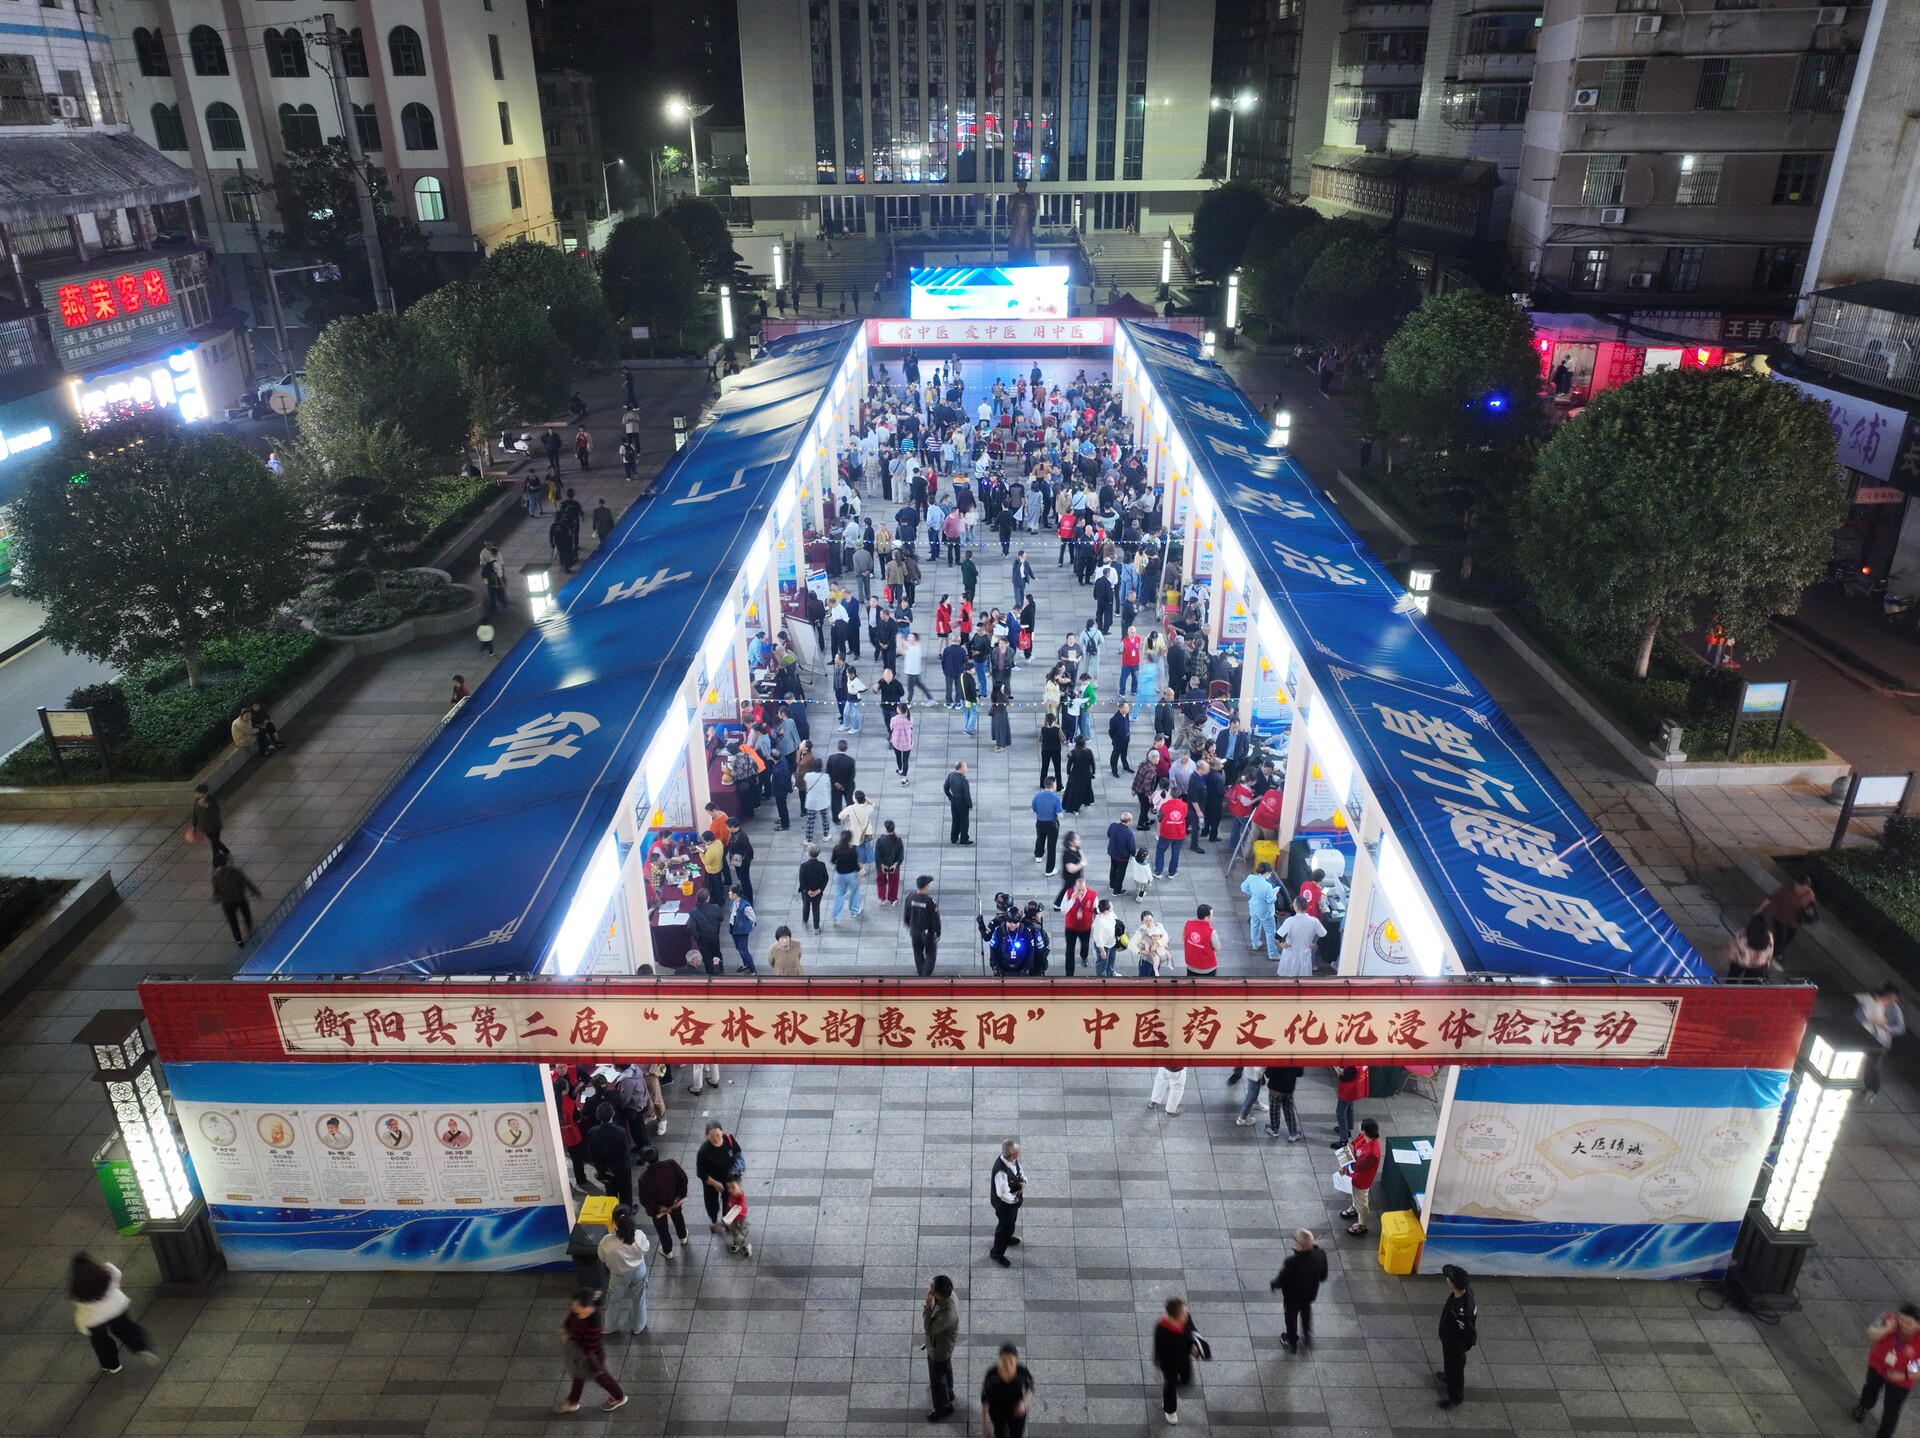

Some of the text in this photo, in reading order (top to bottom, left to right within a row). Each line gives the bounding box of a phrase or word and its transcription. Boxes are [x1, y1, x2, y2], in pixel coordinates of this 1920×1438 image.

[58, 267, 169, 328] 燕荣客栈
[898, 325, 1085, 340] 信中医 爱中医 用中医
[1371, 701, 1634, 954] 智行健康
